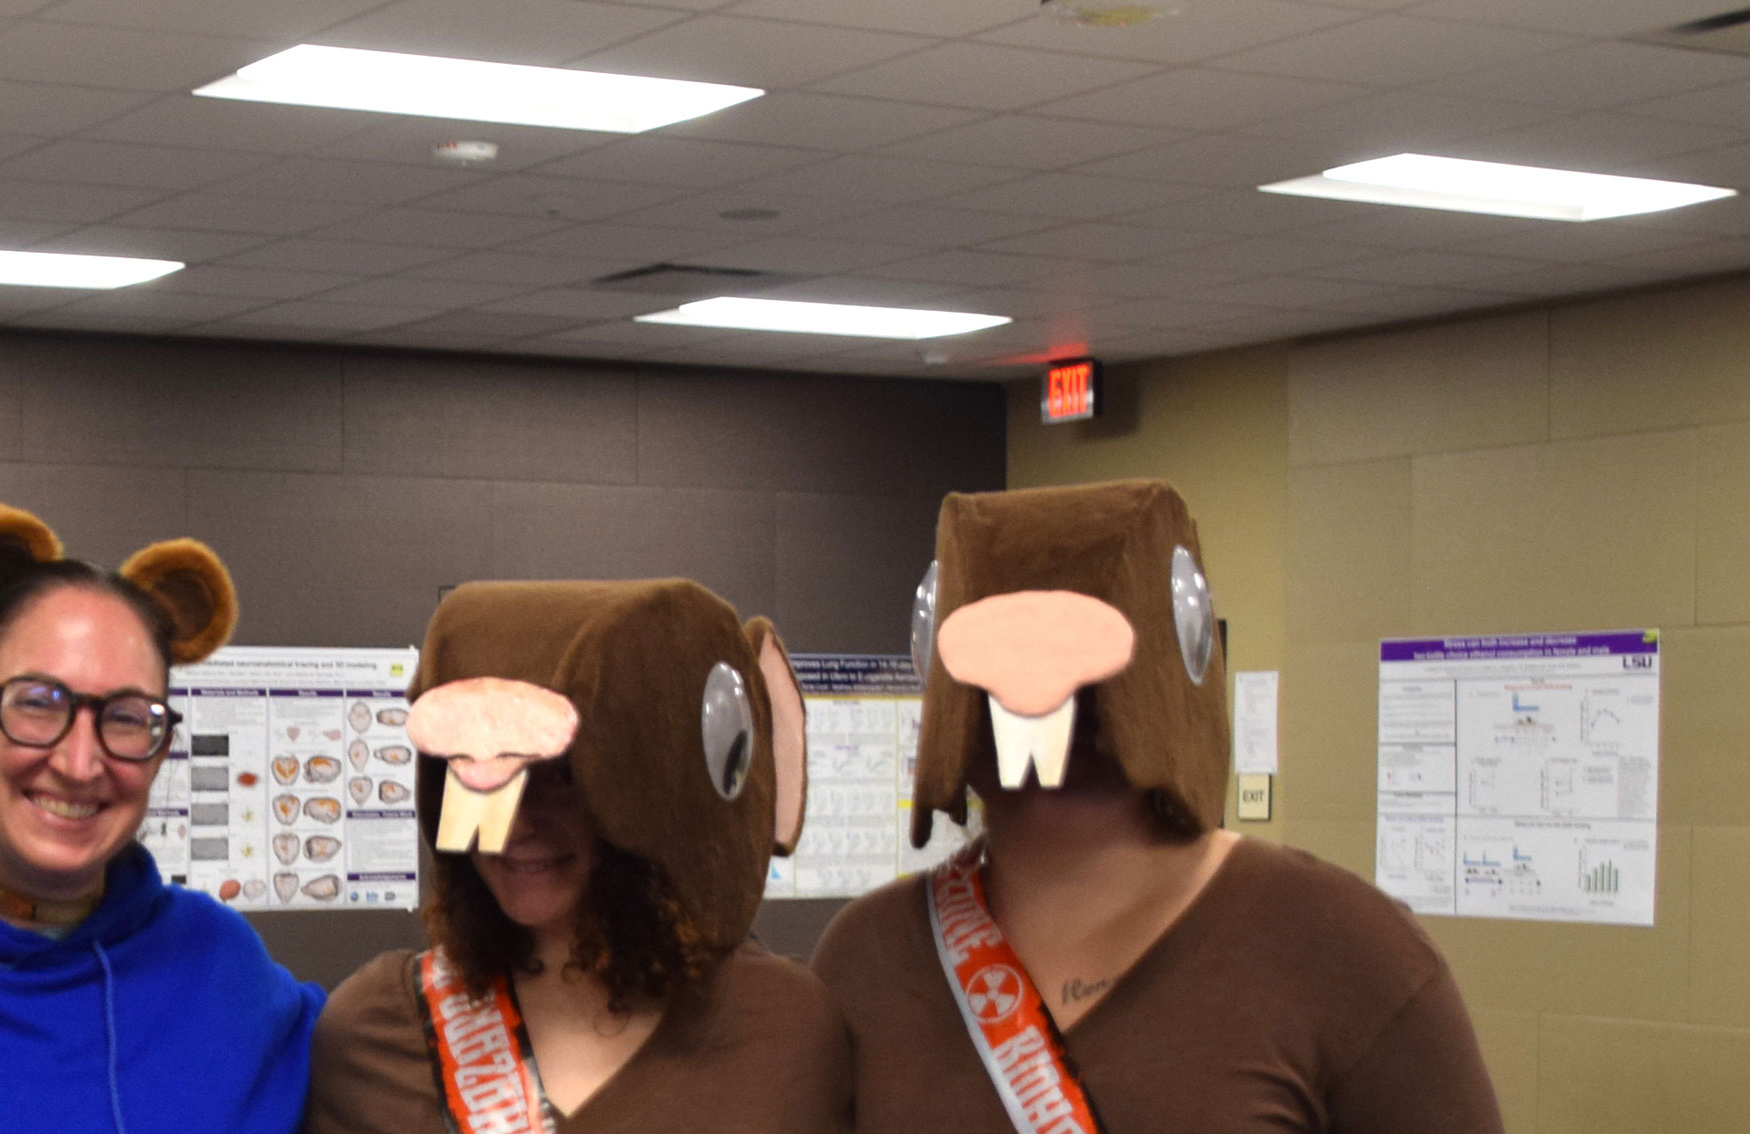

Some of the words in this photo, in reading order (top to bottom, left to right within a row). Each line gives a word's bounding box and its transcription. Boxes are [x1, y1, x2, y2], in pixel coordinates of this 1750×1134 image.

[1048, 364, 1090, 418] EXIT
[1622, 656, 1653, 668] LSU
[1242, 790, 1264, 802] EXIT
